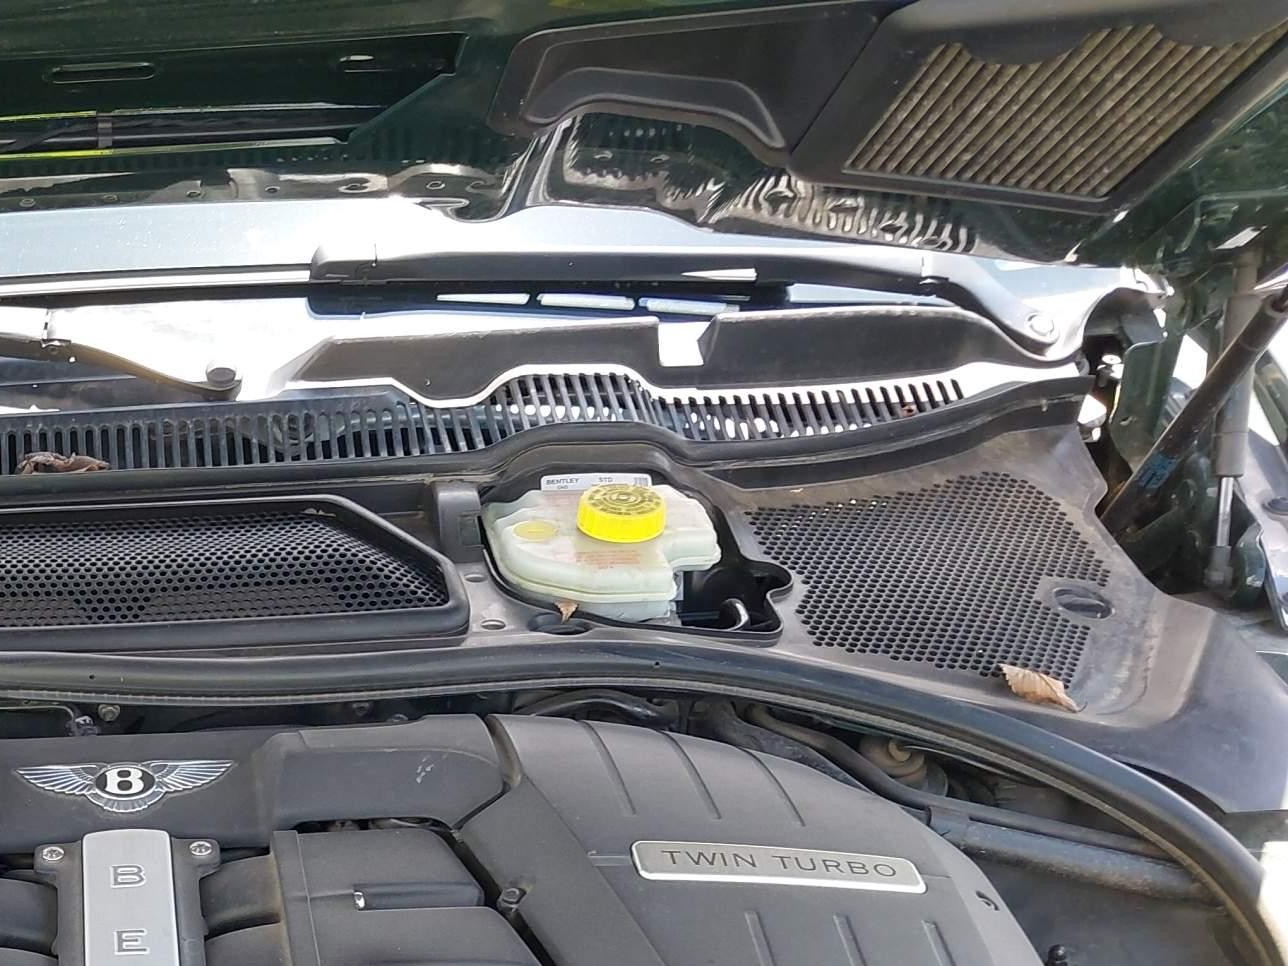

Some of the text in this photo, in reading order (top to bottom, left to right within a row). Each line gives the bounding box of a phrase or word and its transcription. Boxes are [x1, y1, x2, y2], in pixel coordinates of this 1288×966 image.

[105, 767, 144, 794] B
[662, 849, 897, 877] TWIN TURBO
